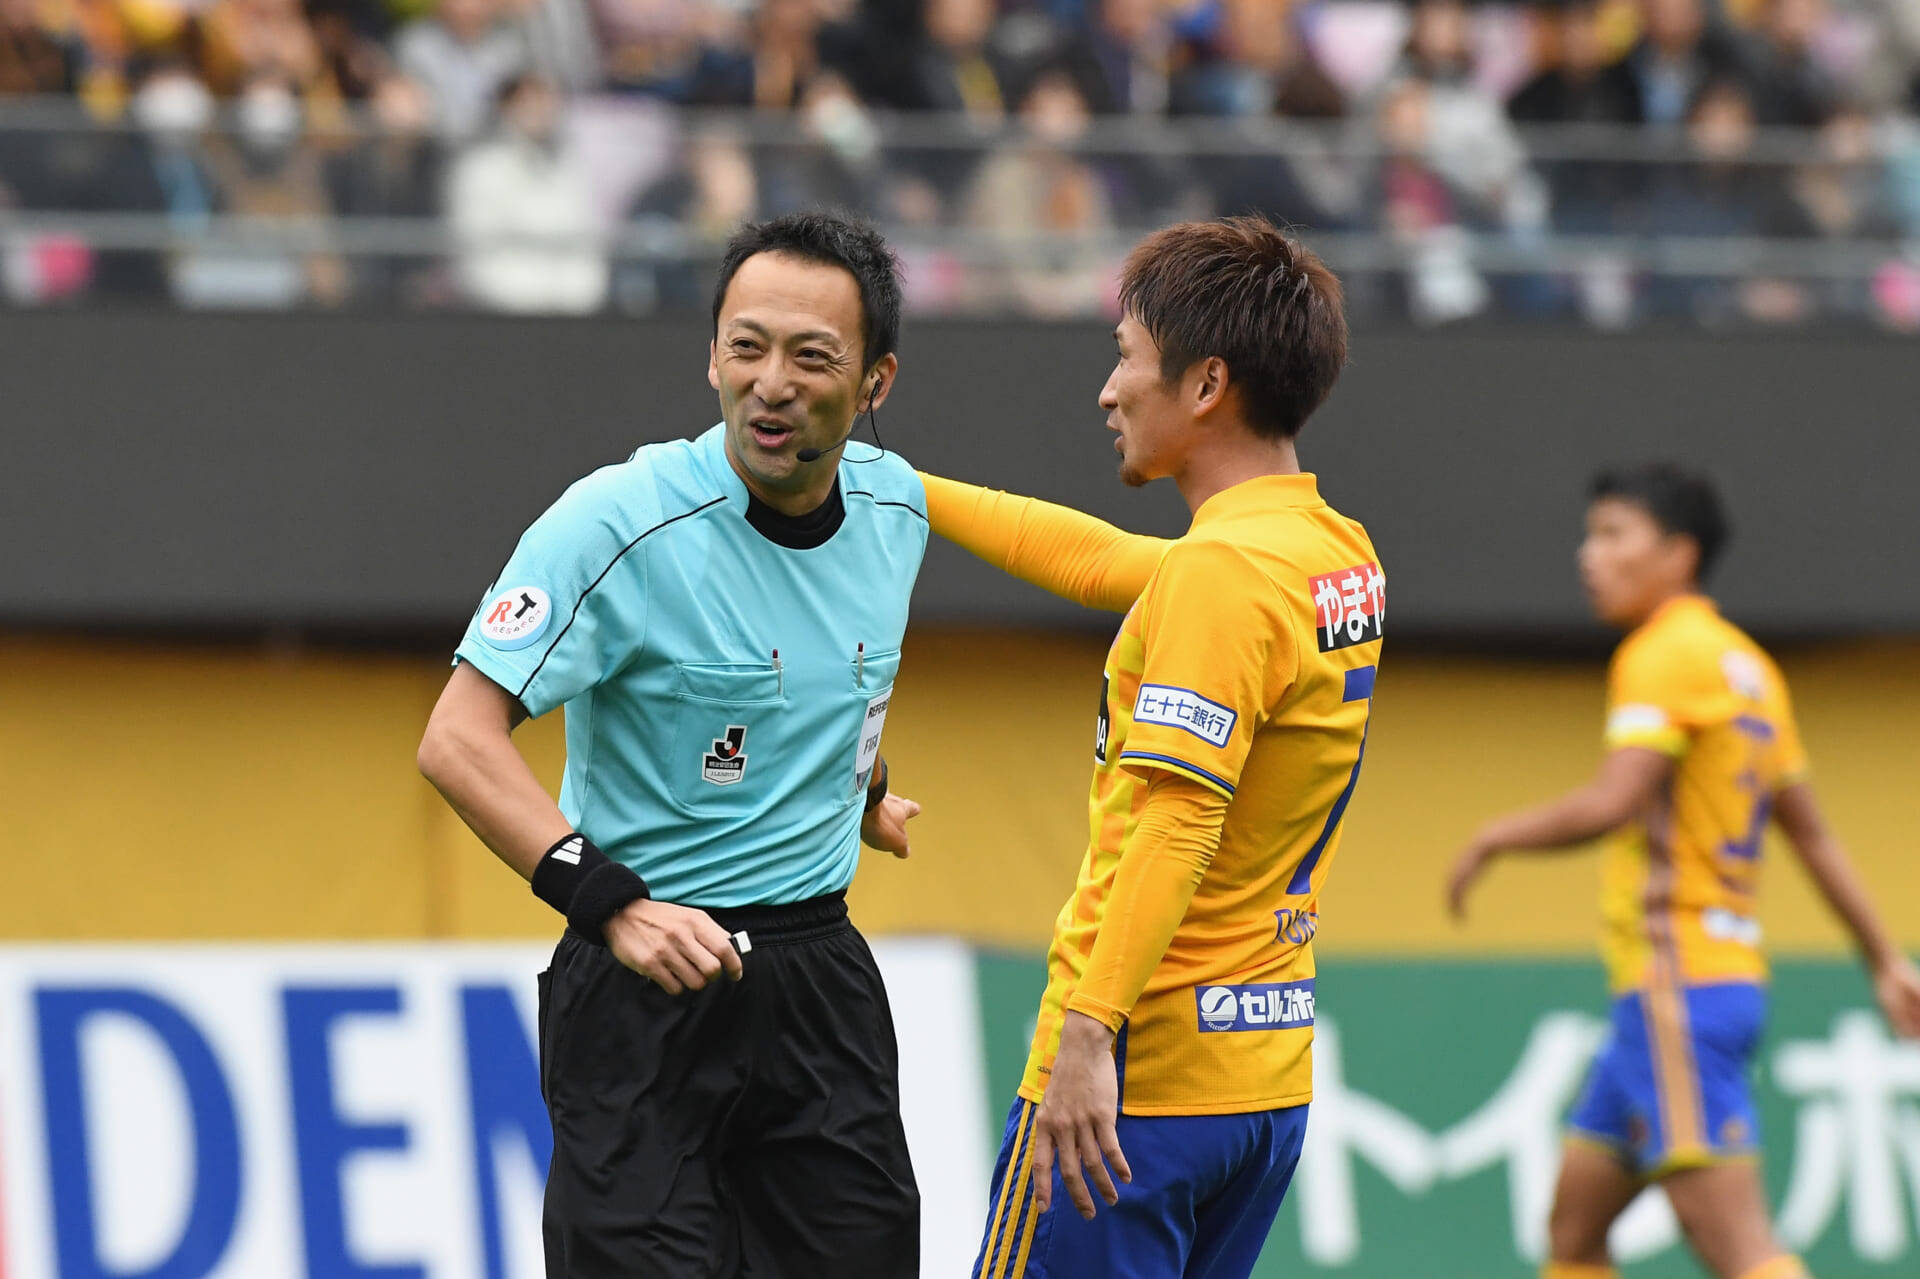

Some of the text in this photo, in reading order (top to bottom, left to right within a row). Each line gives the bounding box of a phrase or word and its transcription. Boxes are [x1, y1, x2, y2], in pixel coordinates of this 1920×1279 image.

[492, 609, 541, 634] RESPECT
[1315, 566, 1385, 648] やまや
[1142, 694, 1227, 736] 七十七銀行
[1285, 665, 1376, 895] 7
[1239, 988, 1315, 1024] セルコホ
